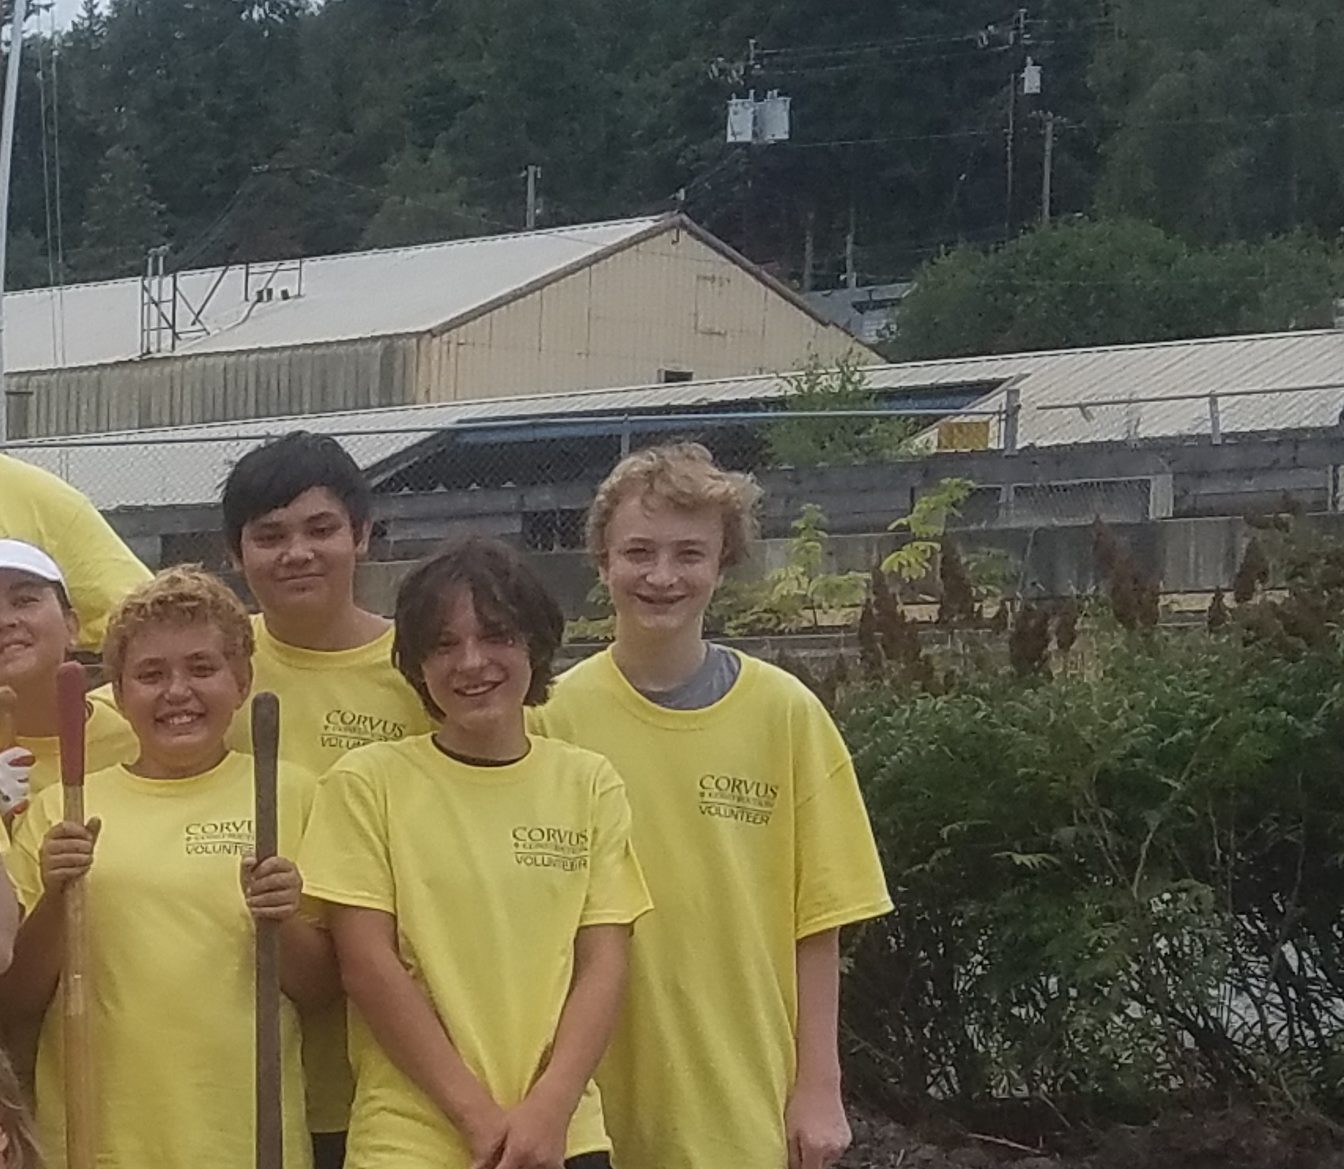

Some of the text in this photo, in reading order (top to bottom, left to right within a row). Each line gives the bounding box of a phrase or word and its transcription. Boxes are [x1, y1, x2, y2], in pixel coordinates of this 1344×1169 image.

[326, 710, 407, 739] CORVUS
[699, 774, 779, 799] CORVUS
[698, 803, 771, 826] VOLUNTEER
[512, 826, 589, 847] CORVUS
